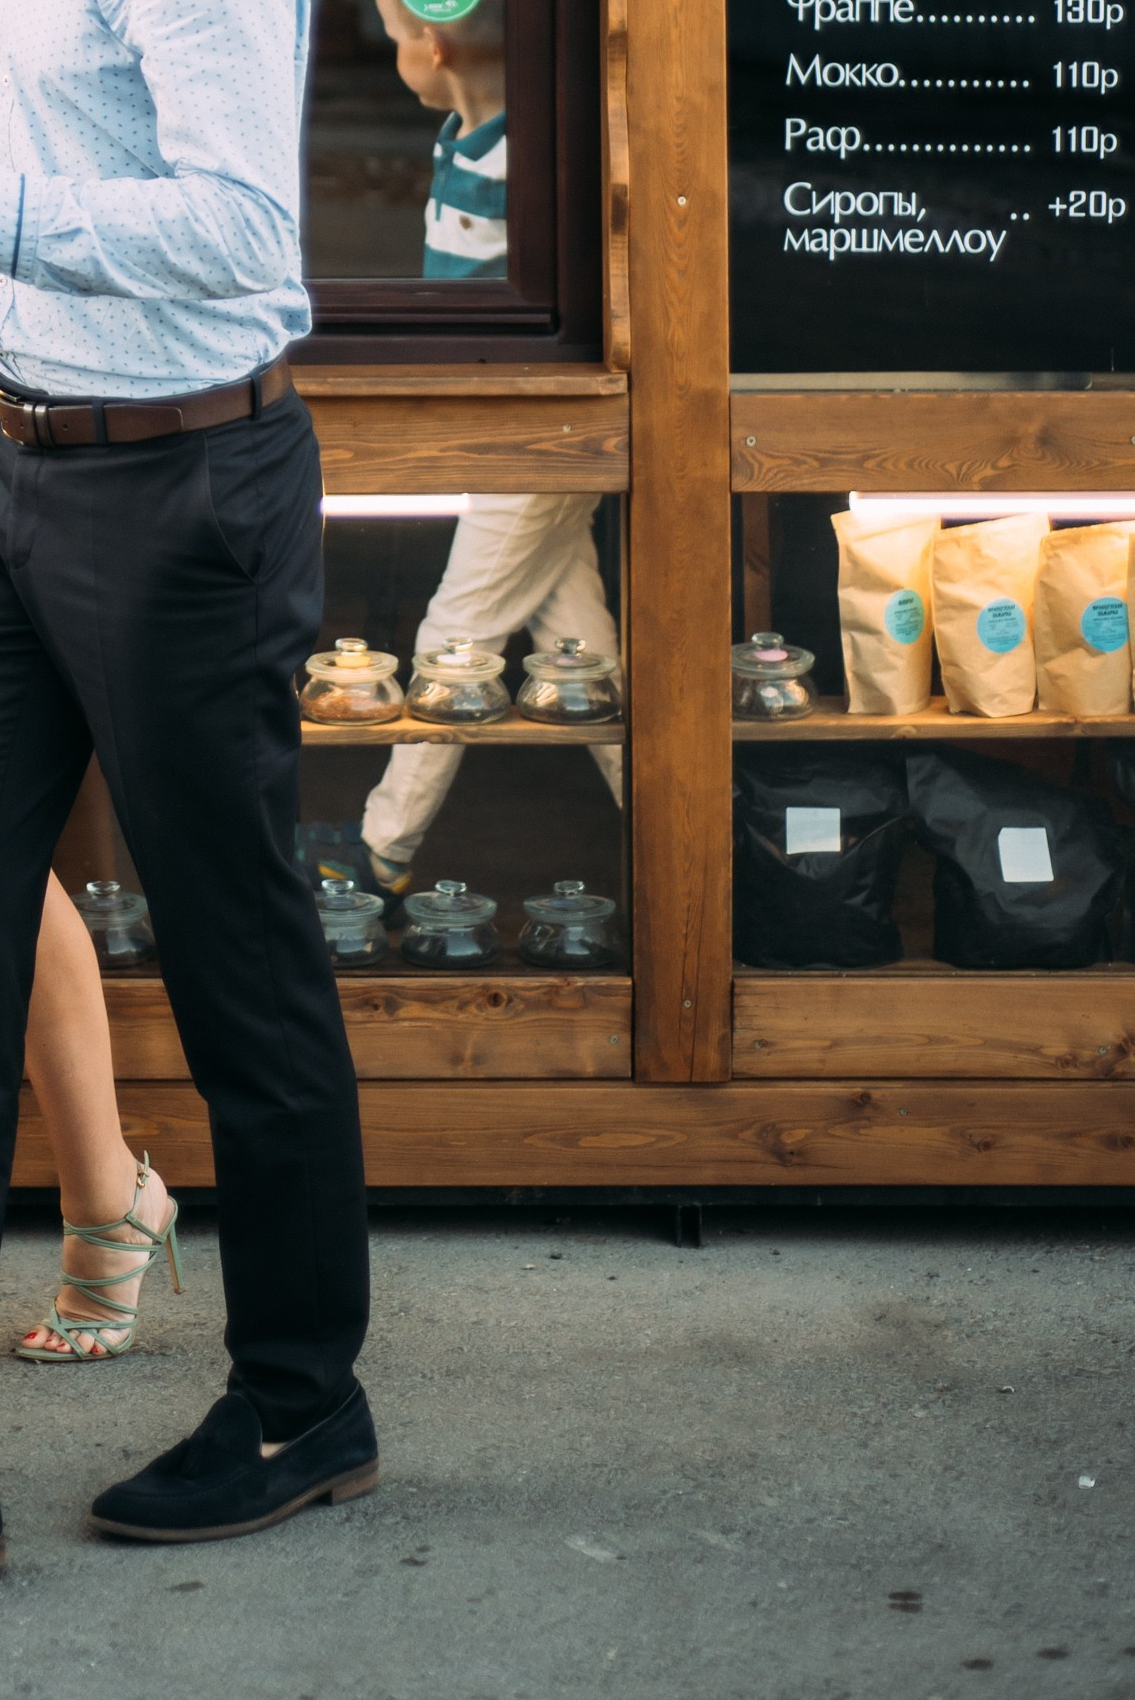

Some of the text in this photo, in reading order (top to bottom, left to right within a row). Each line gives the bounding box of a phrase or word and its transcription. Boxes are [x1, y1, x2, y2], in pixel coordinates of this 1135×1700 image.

[1053, 60, 1119, 95] 110р
[1052, 126, 1118, 160] 110р
[783, 181, 1126, 225] Сиропы, +20р
[783, 227, 1007, 262] маршмеллоу
